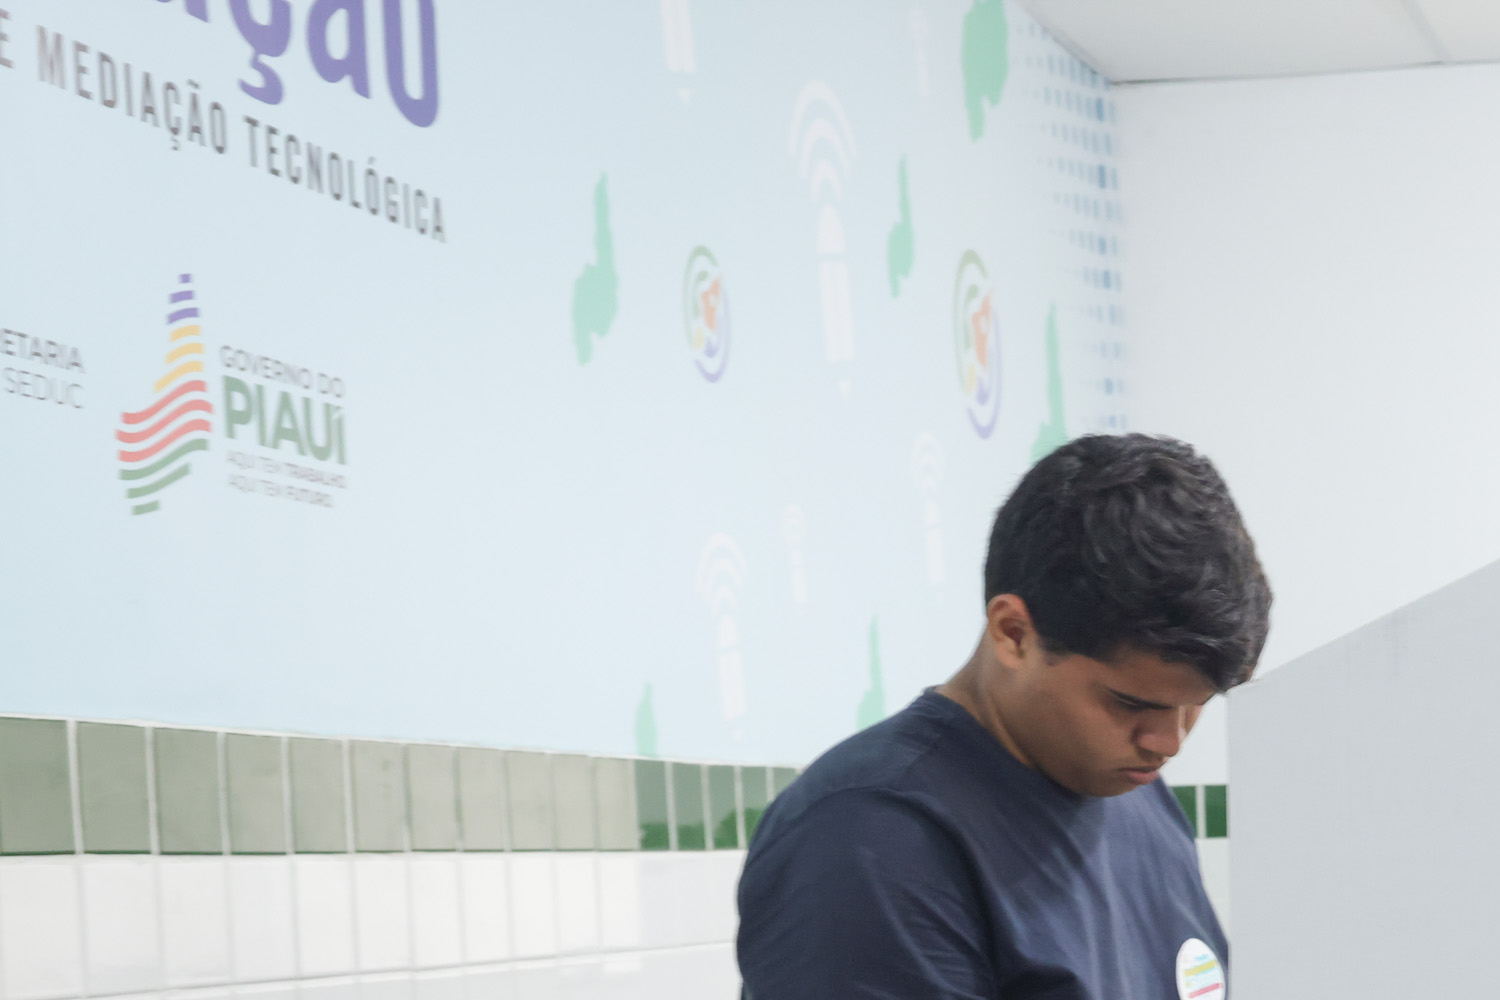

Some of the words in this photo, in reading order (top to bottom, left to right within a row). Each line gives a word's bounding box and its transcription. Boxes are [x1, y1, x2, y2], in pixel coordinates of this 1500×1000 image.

[36, 25, 228, 154] MEDIAÇÃO
[243, 115, 446, 243] TECNOLÓGICA
[2, 367, 85, 409] SEDUC
[220, 345, 313, 390] GOVERNO
[317, 371, 345, 399] DO
[222, 374, 347, 466] PIAUÍ
